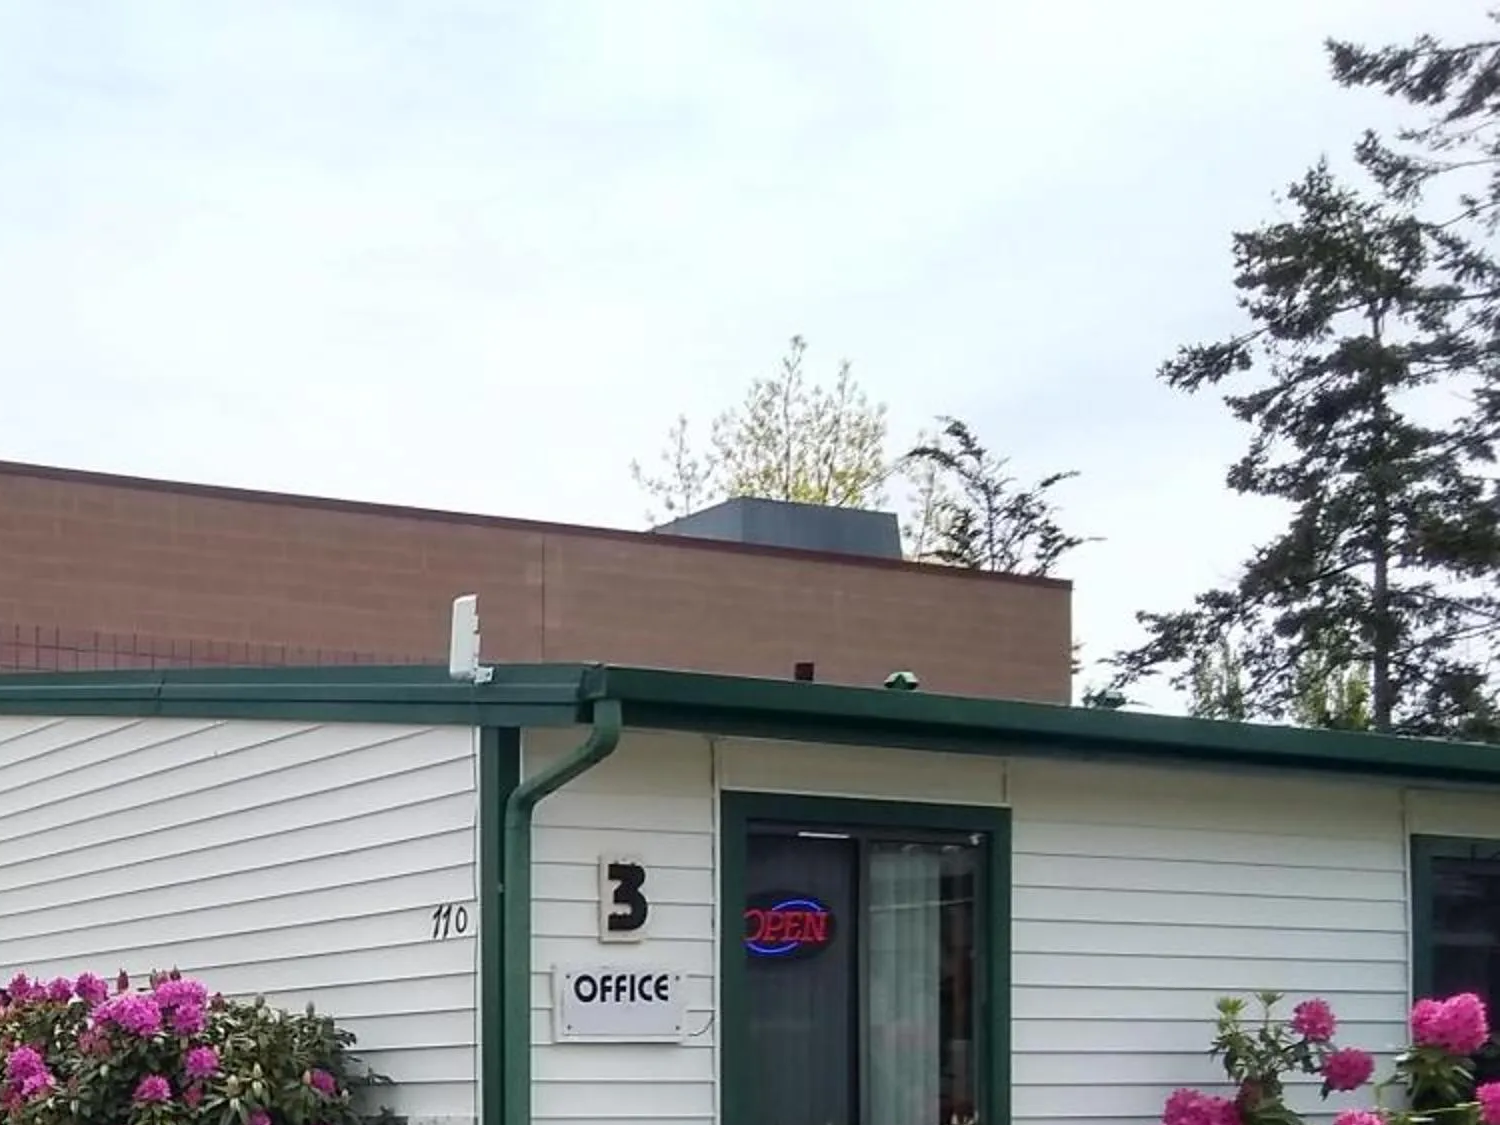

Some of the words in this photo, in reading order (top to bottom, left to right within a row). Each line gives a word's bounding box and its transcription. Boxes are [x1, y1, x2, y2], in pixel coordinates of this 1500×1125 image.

[608, 863, 648, 931] 3
[433, 903, 468, 938] 110
[743, 909, 828, 942] OPEN
[574, 974, 669, 1003] OFFICE
